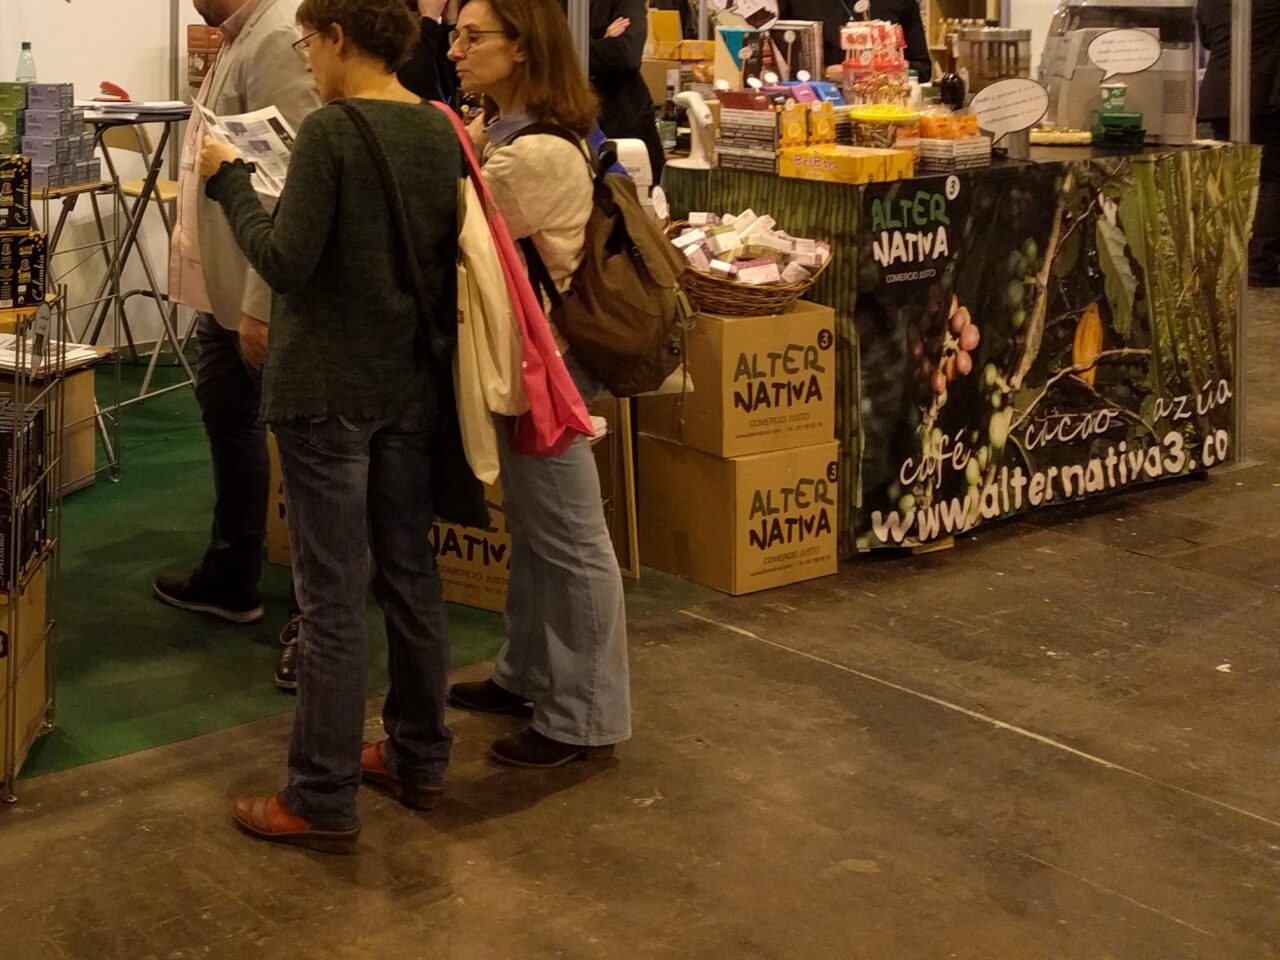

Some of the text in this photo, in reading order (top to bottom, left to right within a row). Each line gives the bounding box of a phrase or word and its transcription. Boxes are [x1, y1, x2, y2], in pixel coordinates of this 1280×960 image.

[871, 190, 950, 232] ALTER
[873, 225, 949, 268] NATIVA
[733, 343, 826, 383] ALTER
[733, 374, 822, 414] NATIVA
[900, 428, 971, 490] café
[749, 477, 834, 520] ALTER
[433, 524, 510, 571] ATIV
[749, 507, 831, 551] NATIVA
